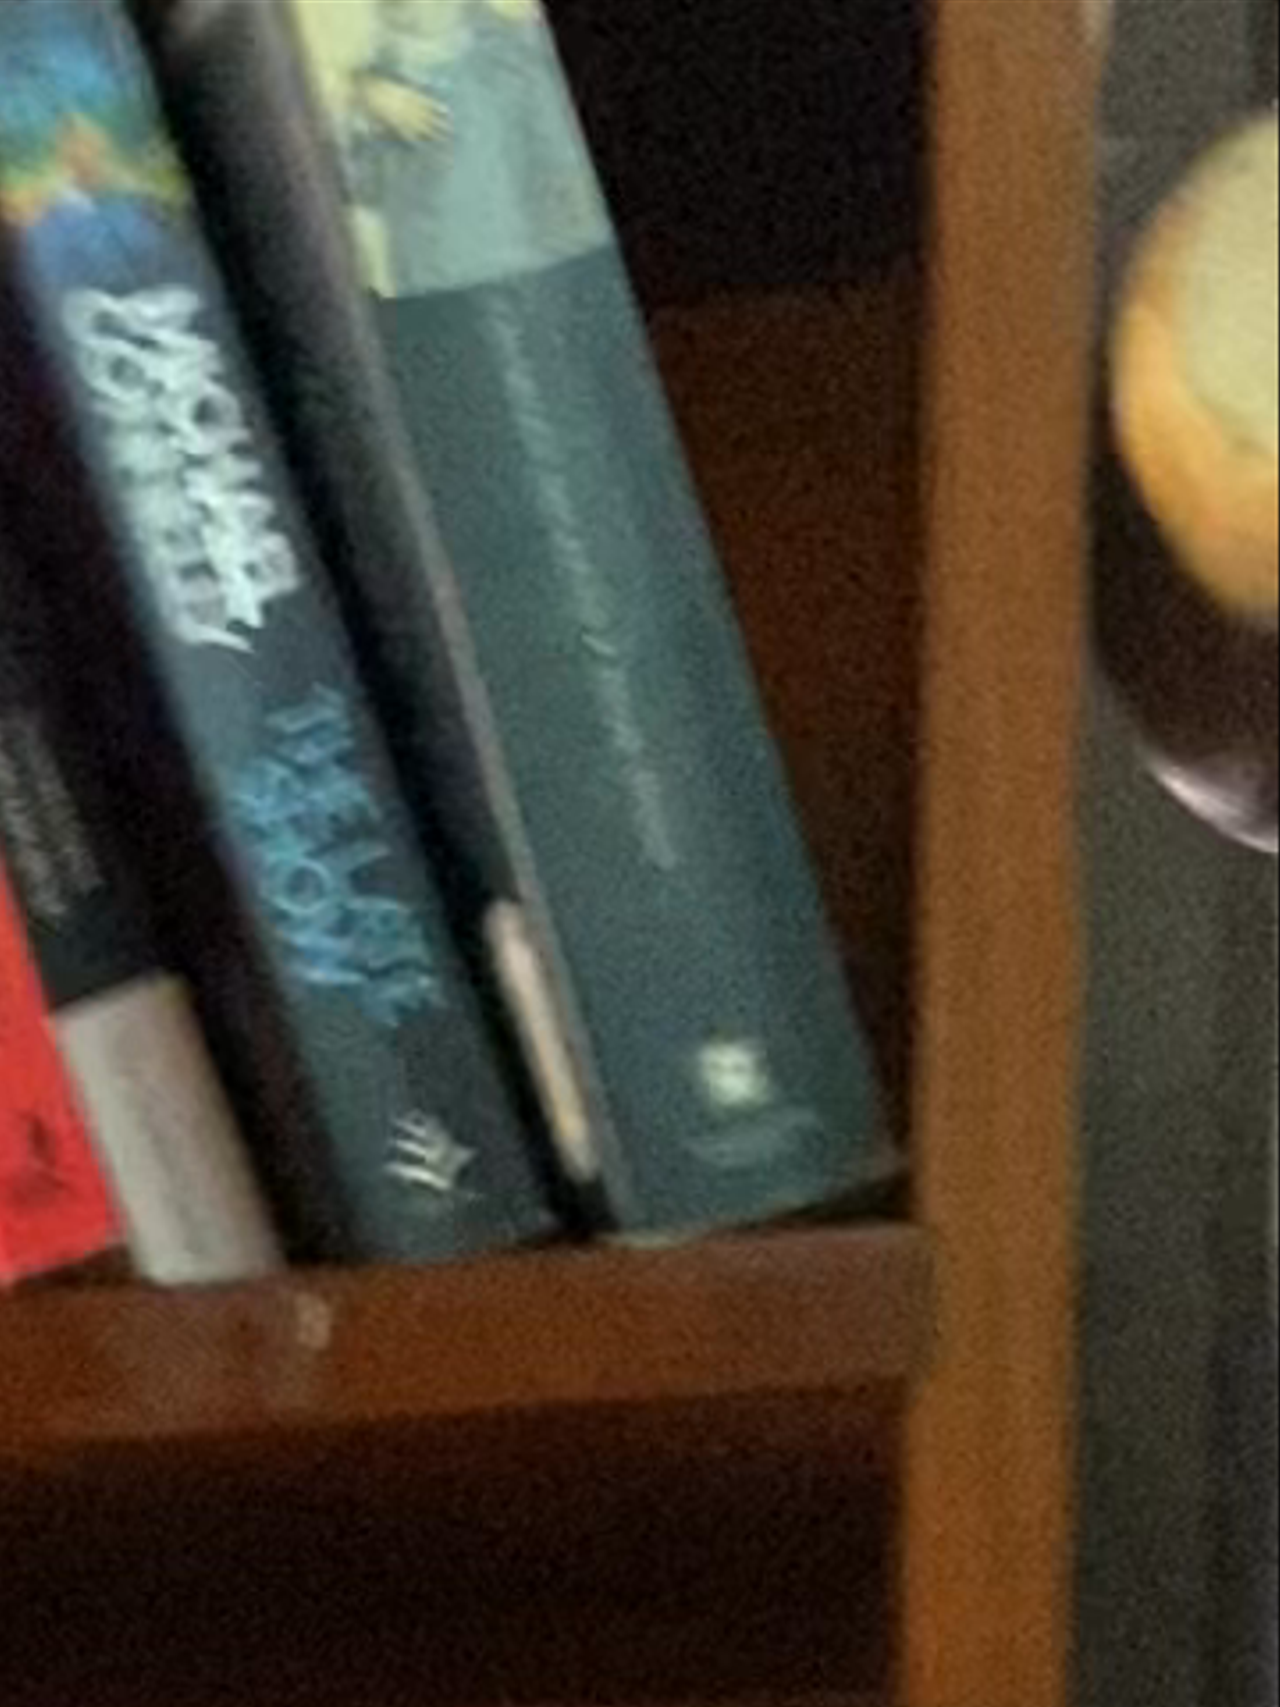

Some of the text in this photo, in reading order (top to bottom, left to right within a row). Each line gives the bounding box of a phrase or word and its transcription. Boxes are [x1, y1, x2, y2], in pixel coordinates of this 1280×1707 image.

[115, 278, 311, 629] MICHAEL
[223, 751, 360, 995] SHOW
[260, 678, 448, 1029] THE LATE
